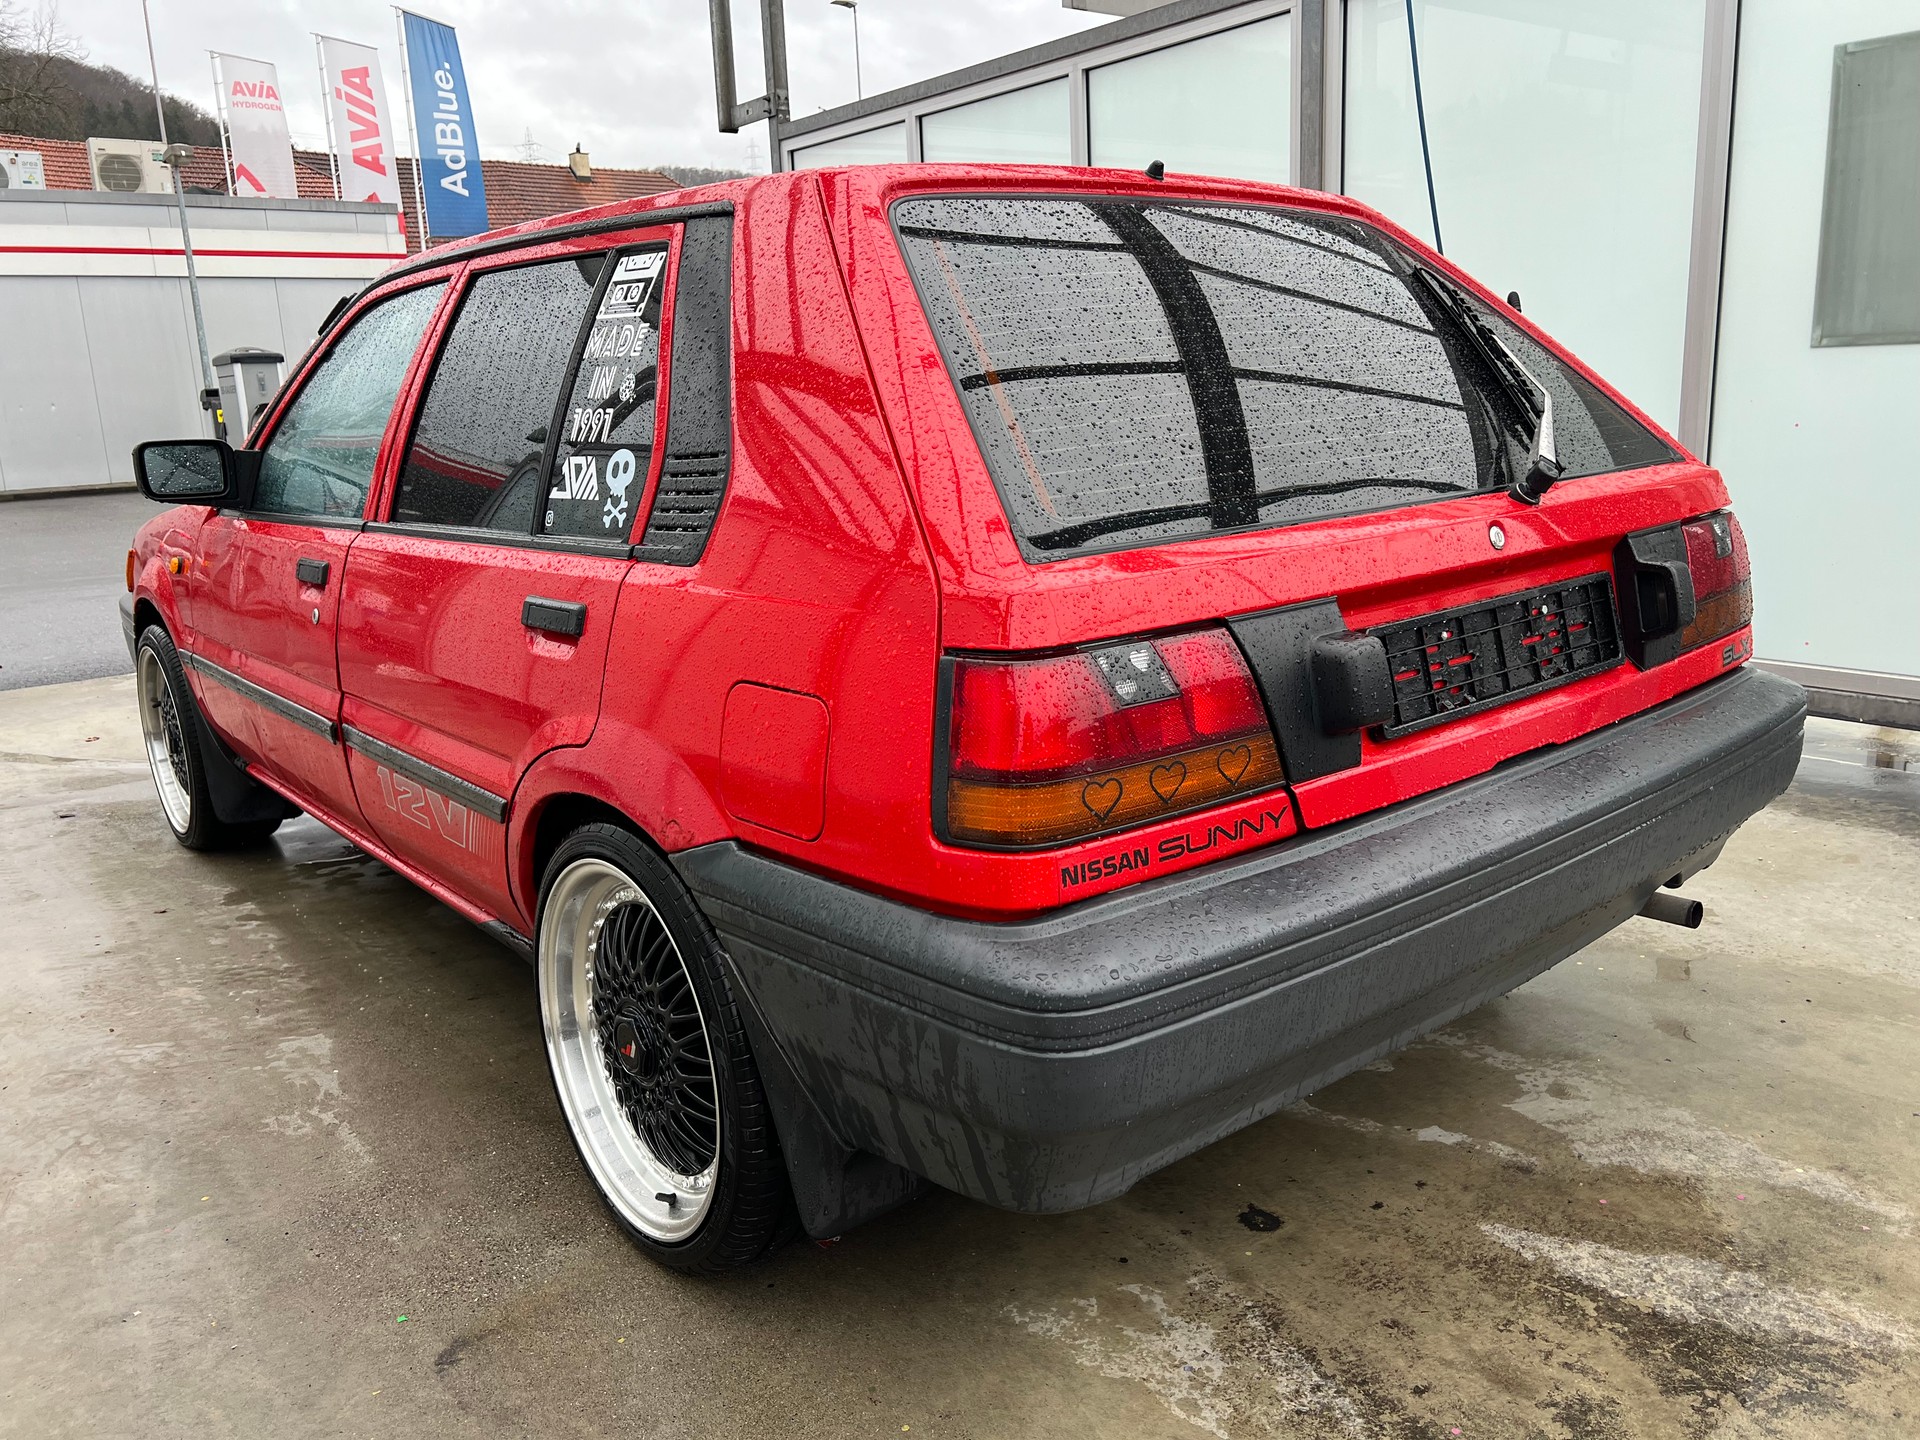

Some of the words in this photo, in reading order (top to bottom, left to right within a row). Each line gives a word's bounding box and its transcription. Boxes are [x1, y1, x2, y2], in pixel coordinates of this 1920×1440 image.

[232, 101, 282, 112] HYDROGEN
[433, 61, 470, 197] AdBlue.
[583, 322, 650, 359] MADE
[587, 366, 618, 399] IN
[570, 408, 615, 443] 1991
[1722, 635, 1751, 667] SLX
[377, 765, 467, 849] 12V
[1061, 846, 1150, 889] NISSAN
[1157, 805, 1289, 863] SUNNY
